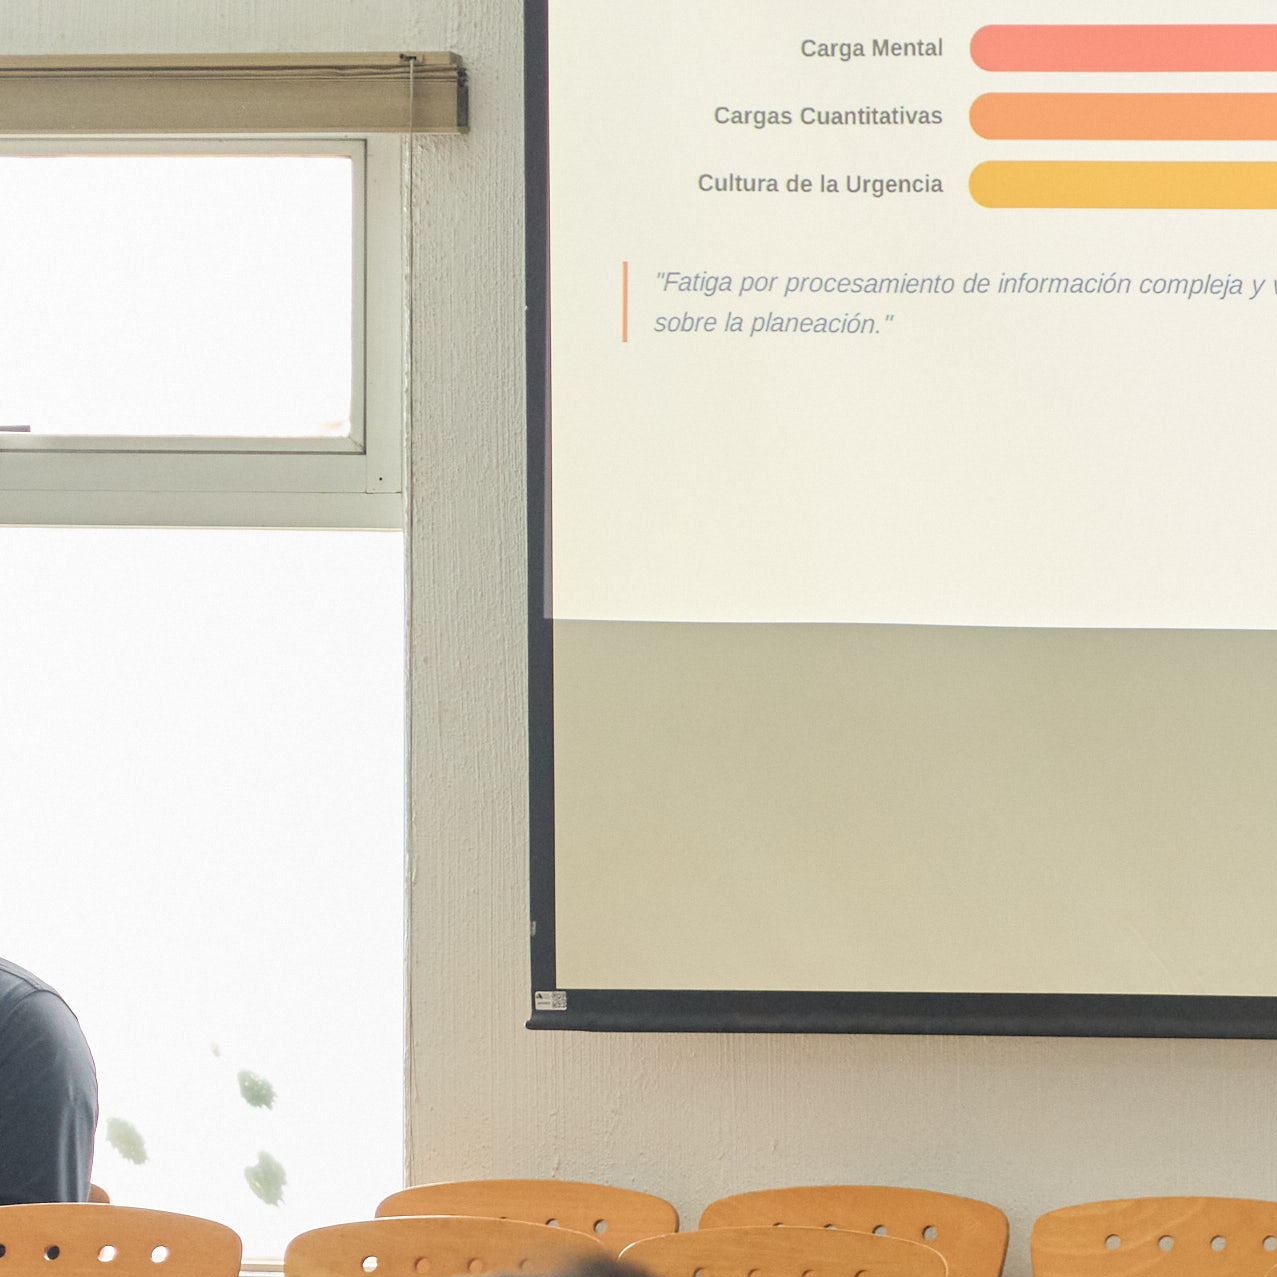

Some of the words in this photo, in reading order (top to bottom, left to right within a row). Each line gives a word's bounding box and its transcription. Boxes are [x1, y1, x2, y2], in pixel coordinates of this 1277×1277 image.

[800, 39, 866, 63] Carga
[872, 37, 943, 57] Mental
[713, 106, 793, 130] Cargas
[799, 105, 943, 126] Cuantitativas
[697, 172, 780, 193] Cultura
[785, 173, 813, 193] de
[820, 173, 840, 193] la
[846, 173, 944, 199] Urgencia
[656, 270, 733, 297] "Fatiga
[738, 275, 779, 297] por
[783, 272, 955, 298] procesamiento
[962, 272, 991, 294] de
[997, 271, 1132, 294] información
[1139, 273, 1244, 301] compleja
[1248, 279, 1267, 301] y
[653, 311, 718, 333] sobre
[724, 311, 744, 333] la
[749, 311, 895, 338] planeación."
